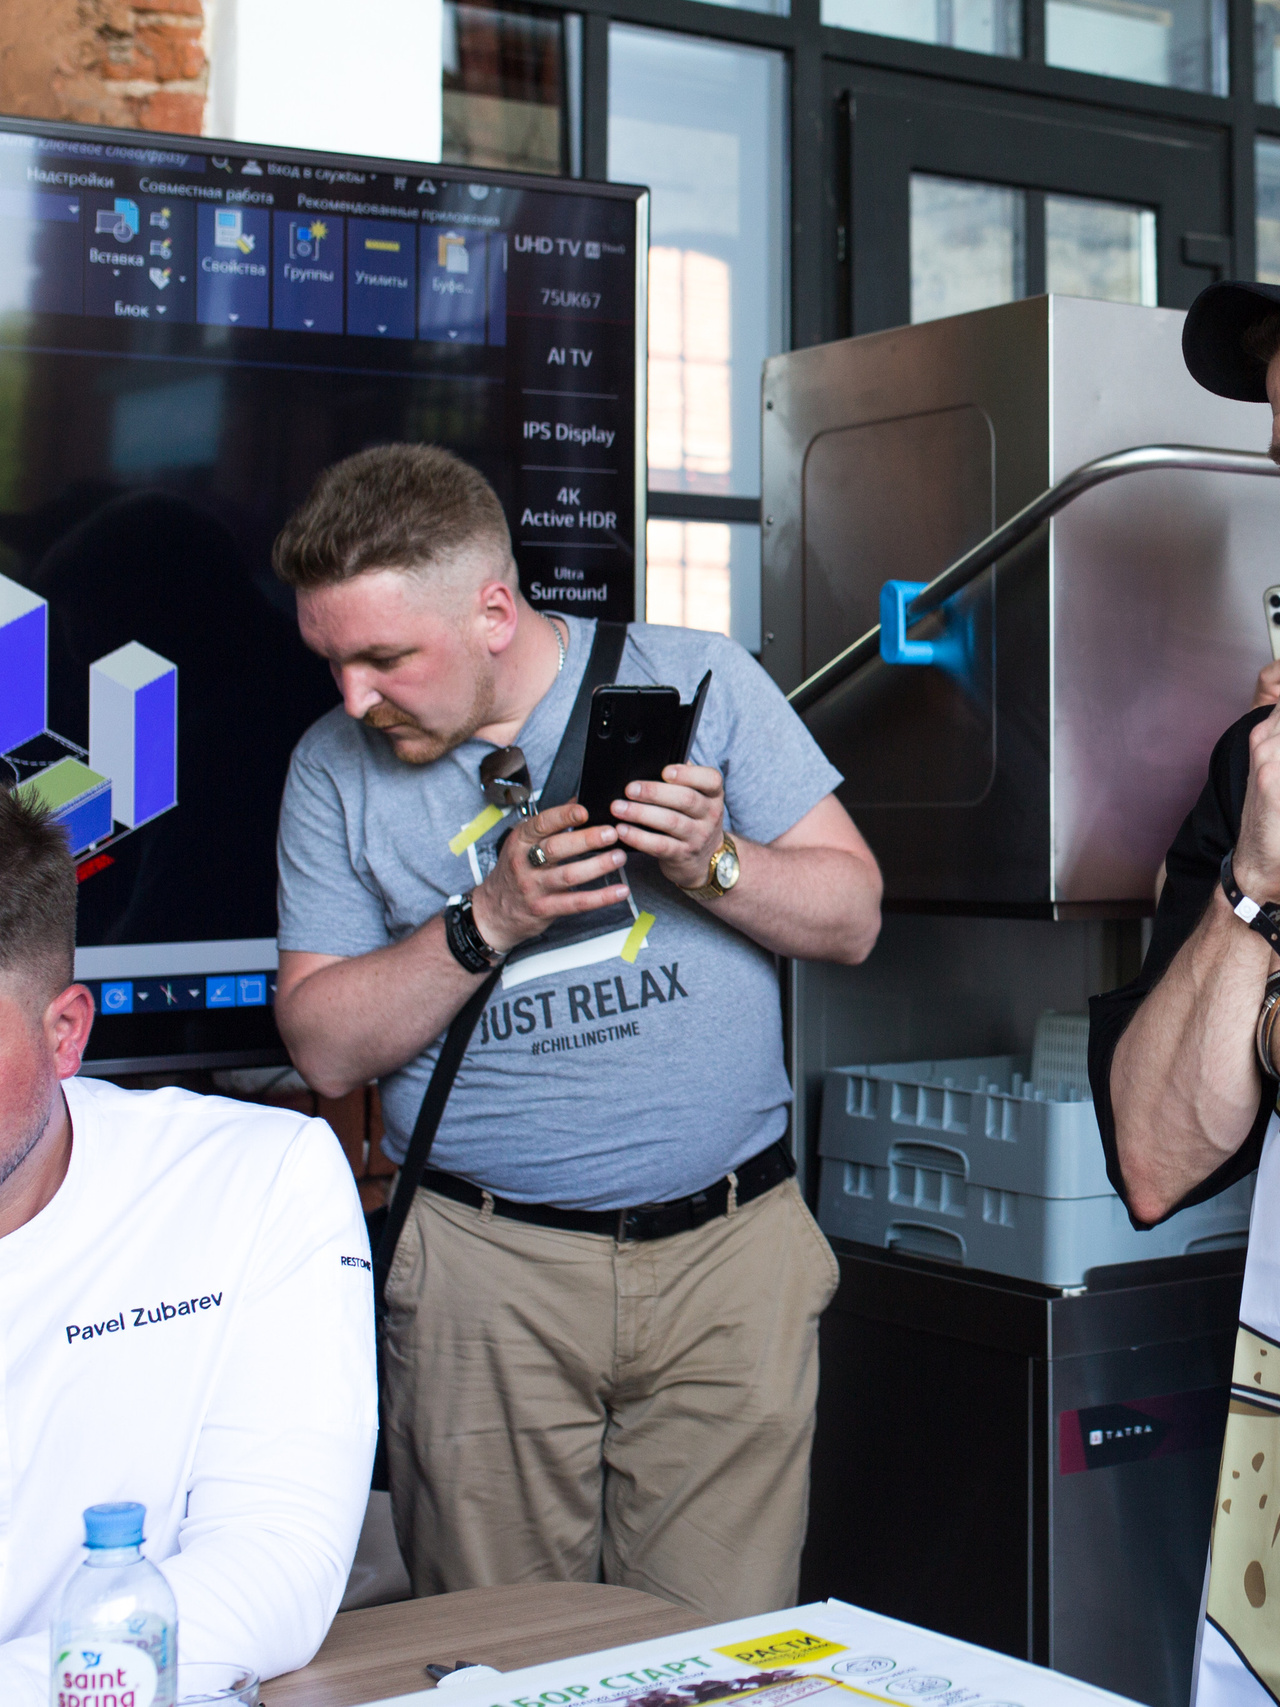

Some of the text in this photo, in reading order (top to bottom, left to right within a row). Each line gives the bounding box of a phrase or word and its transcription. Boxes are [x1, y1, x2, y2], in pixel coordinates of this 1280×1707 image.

[27, 166, 115, 188] Надстройки
[267, 162, 366, 185] Вход в службы
[139, 176, 275, 205] Совместная работа
[297, 192, 419, 220] Рекомендованные
[89, 247, 145, 267] Вставка
[514, 234, 554, 255] UHD
[556, 237, 581, 257] TV
[201, 256, 267, 277] Свойства
[283, 263, 335, 283] Группы
[355, 270, 408, 289] Утилиты
[114, 300, 150, 318] Блок
[540, 287, 602, 310] 75UK67
[547, 347, 593, 367] AI TV
[523, 420, 616, 448] IPS Display
[556, 486, 582, 506] 4K
[520, 507, 618, 530] Active HDR
[554, 566, 585, 581] Ultra
[530, 581, 608, 602] Surround
[480, 961, 689, 1046] JUST RELAX
[530, 1020, 641, 1056] #CHILLINGTIME
[65, 1291, 224, 1344] Pavel Zubarev
[735, 1635, 822, 1662] РАСТИ
[63, 1668, 127, 1690] saint
[598, 1655, 713, 1691] СТАРТ
